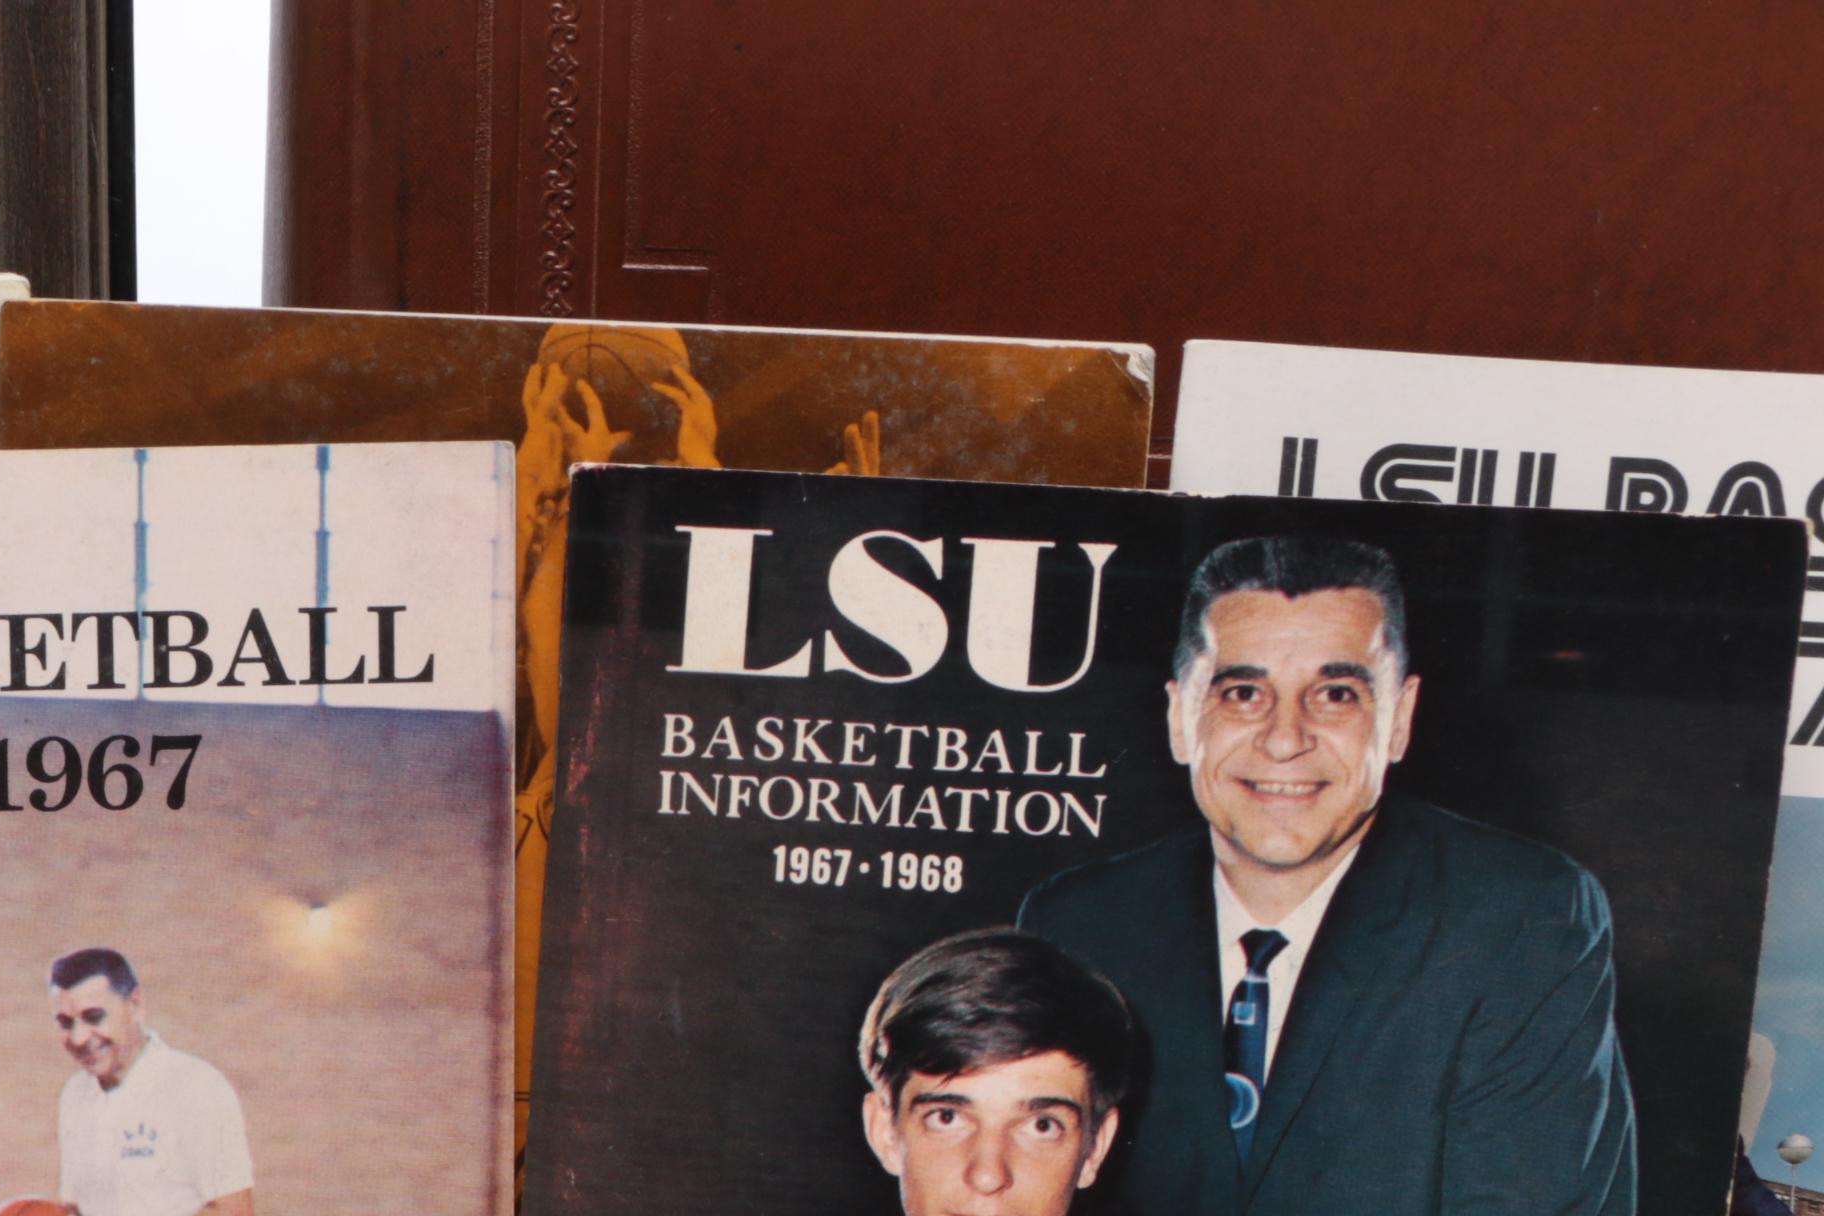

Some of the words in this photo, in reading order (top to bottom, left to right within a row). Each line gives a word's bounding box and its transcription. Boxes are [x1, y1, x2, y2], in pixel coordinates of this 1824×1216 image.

[664, 525, 1120, 693] LSU
[660, 712, 1109, 779] BASKETBALL
[656, 769, 1109, 840] INFORMATION
